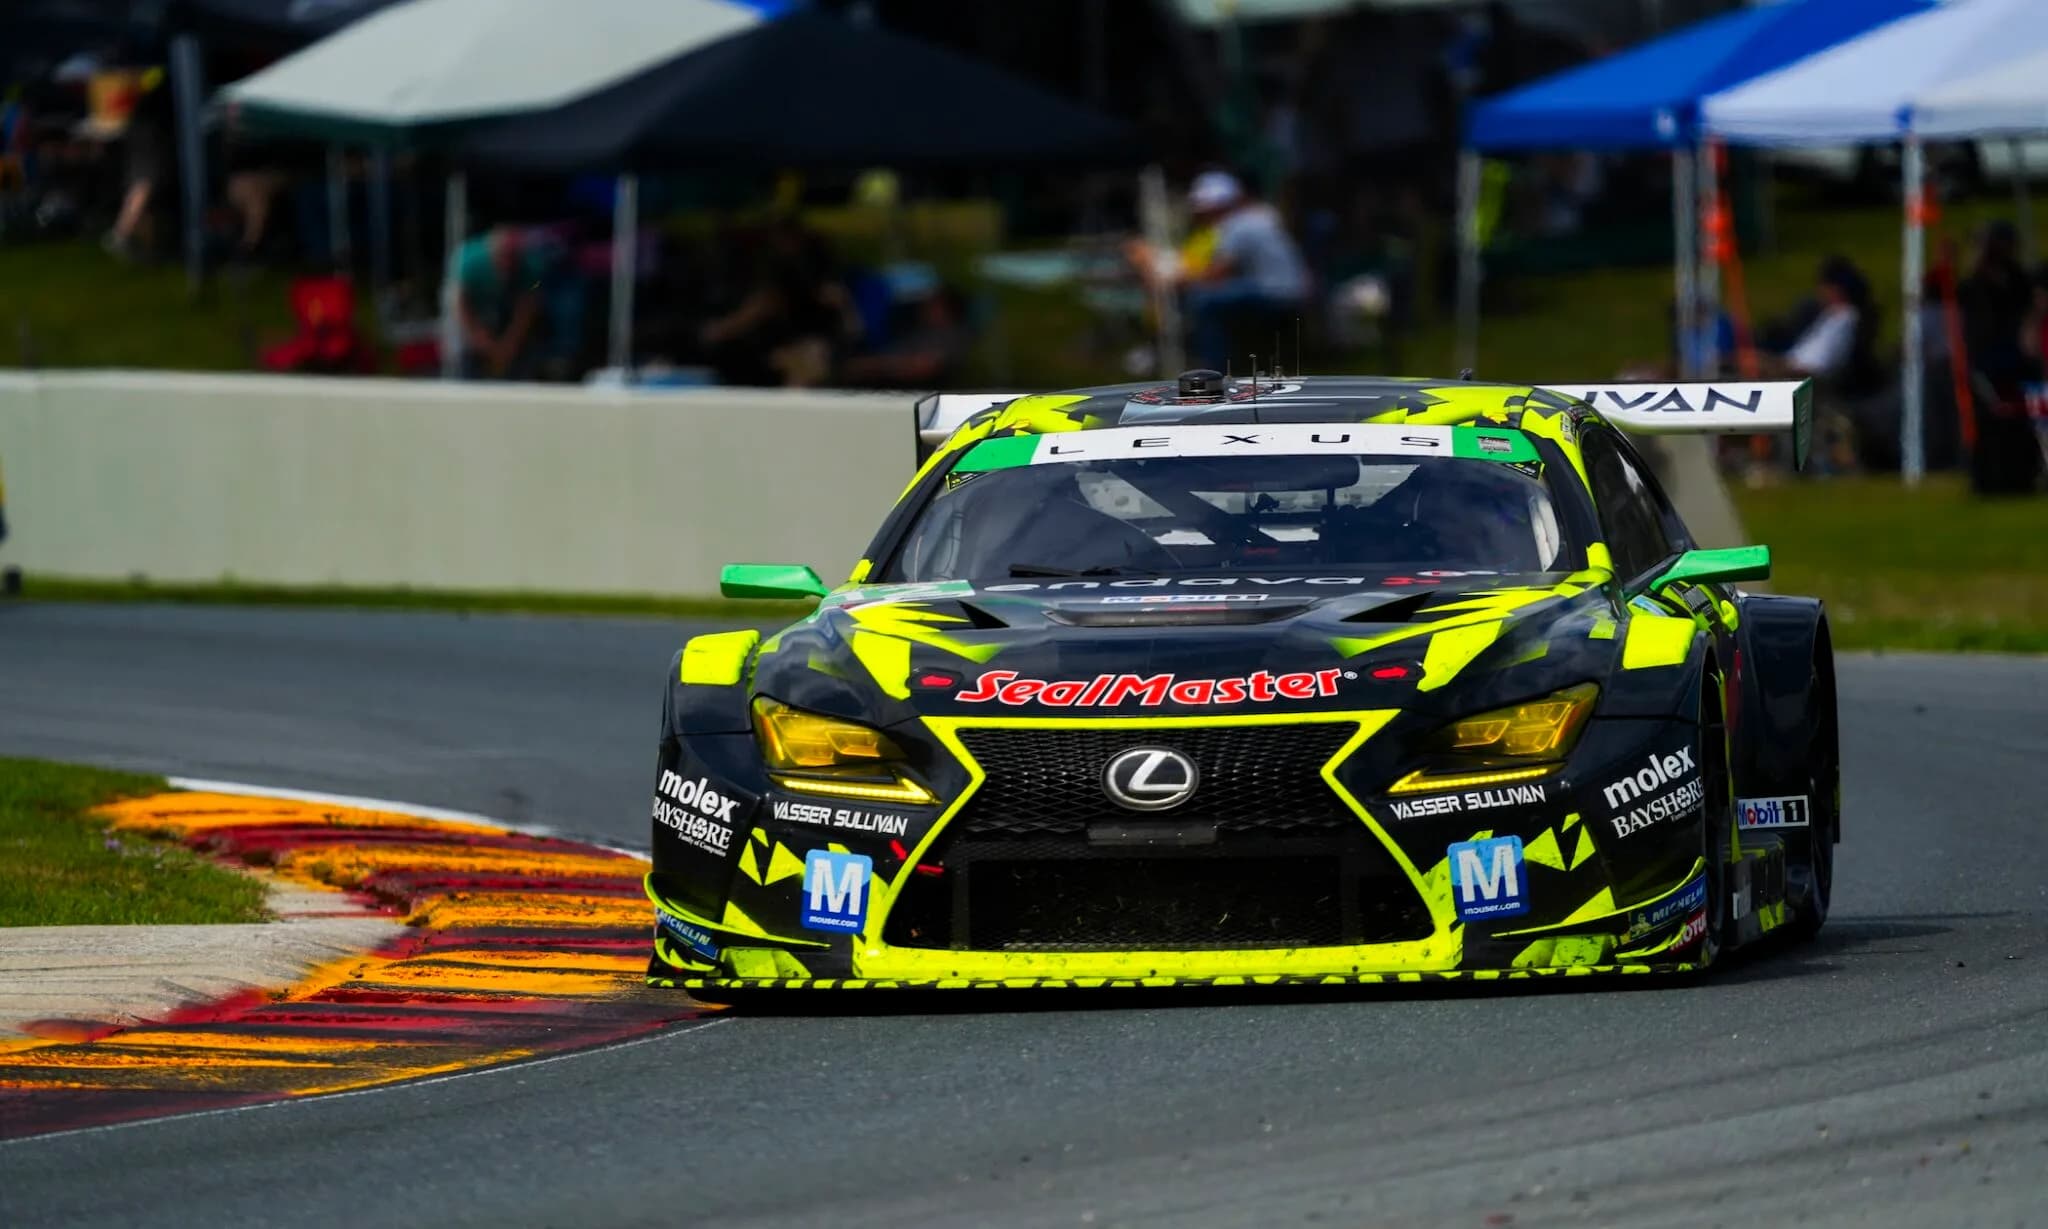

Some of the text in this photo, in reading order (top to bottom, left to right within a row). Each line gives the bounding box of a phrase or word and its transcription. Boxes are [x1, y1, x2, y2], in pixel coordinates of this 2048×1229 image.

[1050, 433, 1441, 455] LEXUS
[983, 577, 1364, 591] endava
[955, 669, 1344, 706] SealMaster
[1603, 746, 1695, 809] molex
[658, 768, 737, 823] molex
[1389, 784, 1546, 820] VASSER SULLIVAN
[773, 801, 908, 836] VASSER SULLIVAN
[1738, 800, 1780, 827] Mobil
[809, 858, 865, 916] M
[1457, 843, 1520, 903] M
[808, 915, 859, 928] mouser.com
[1464, 902, 1521, 915] mouser.com
